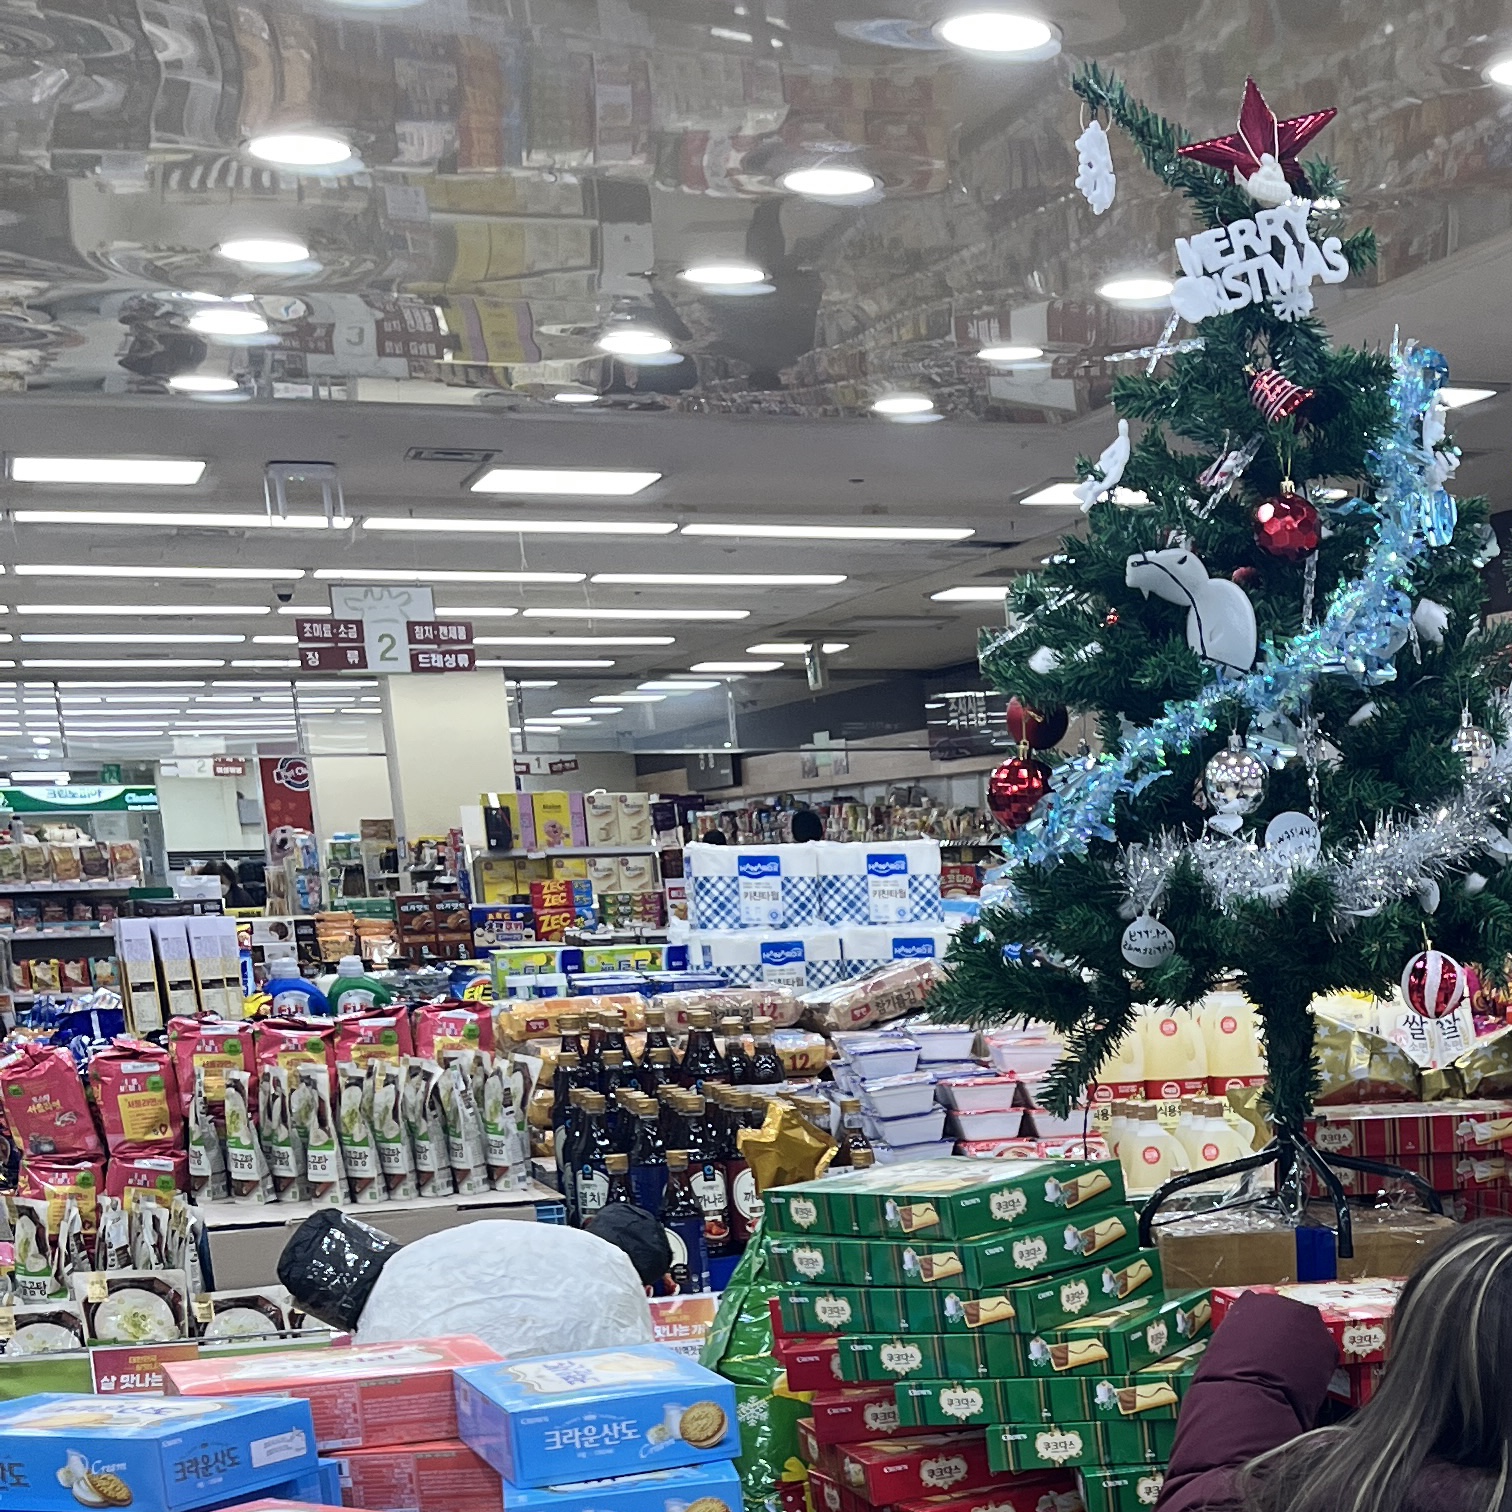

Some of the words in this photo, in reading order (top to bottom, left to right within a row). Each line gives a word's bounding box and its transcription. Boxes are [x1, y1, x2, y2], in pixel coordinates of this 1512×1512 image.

[1175, 200, 1310, 277] MERRY
[1171, 237, 1349, 316] ISTMAS
[378, 633, 398, 661] 2
[543, 893, 567, 907] ZEC
[539, 912, 571, 933] ZEC
[100, 1375, 117, 1391] 살
[121, 1373, 163, 1391] 맛나는
[544, 1420, 641, 1451] 크라운산도
[1042, 1438, 1081, 1452] 쿠크다스
